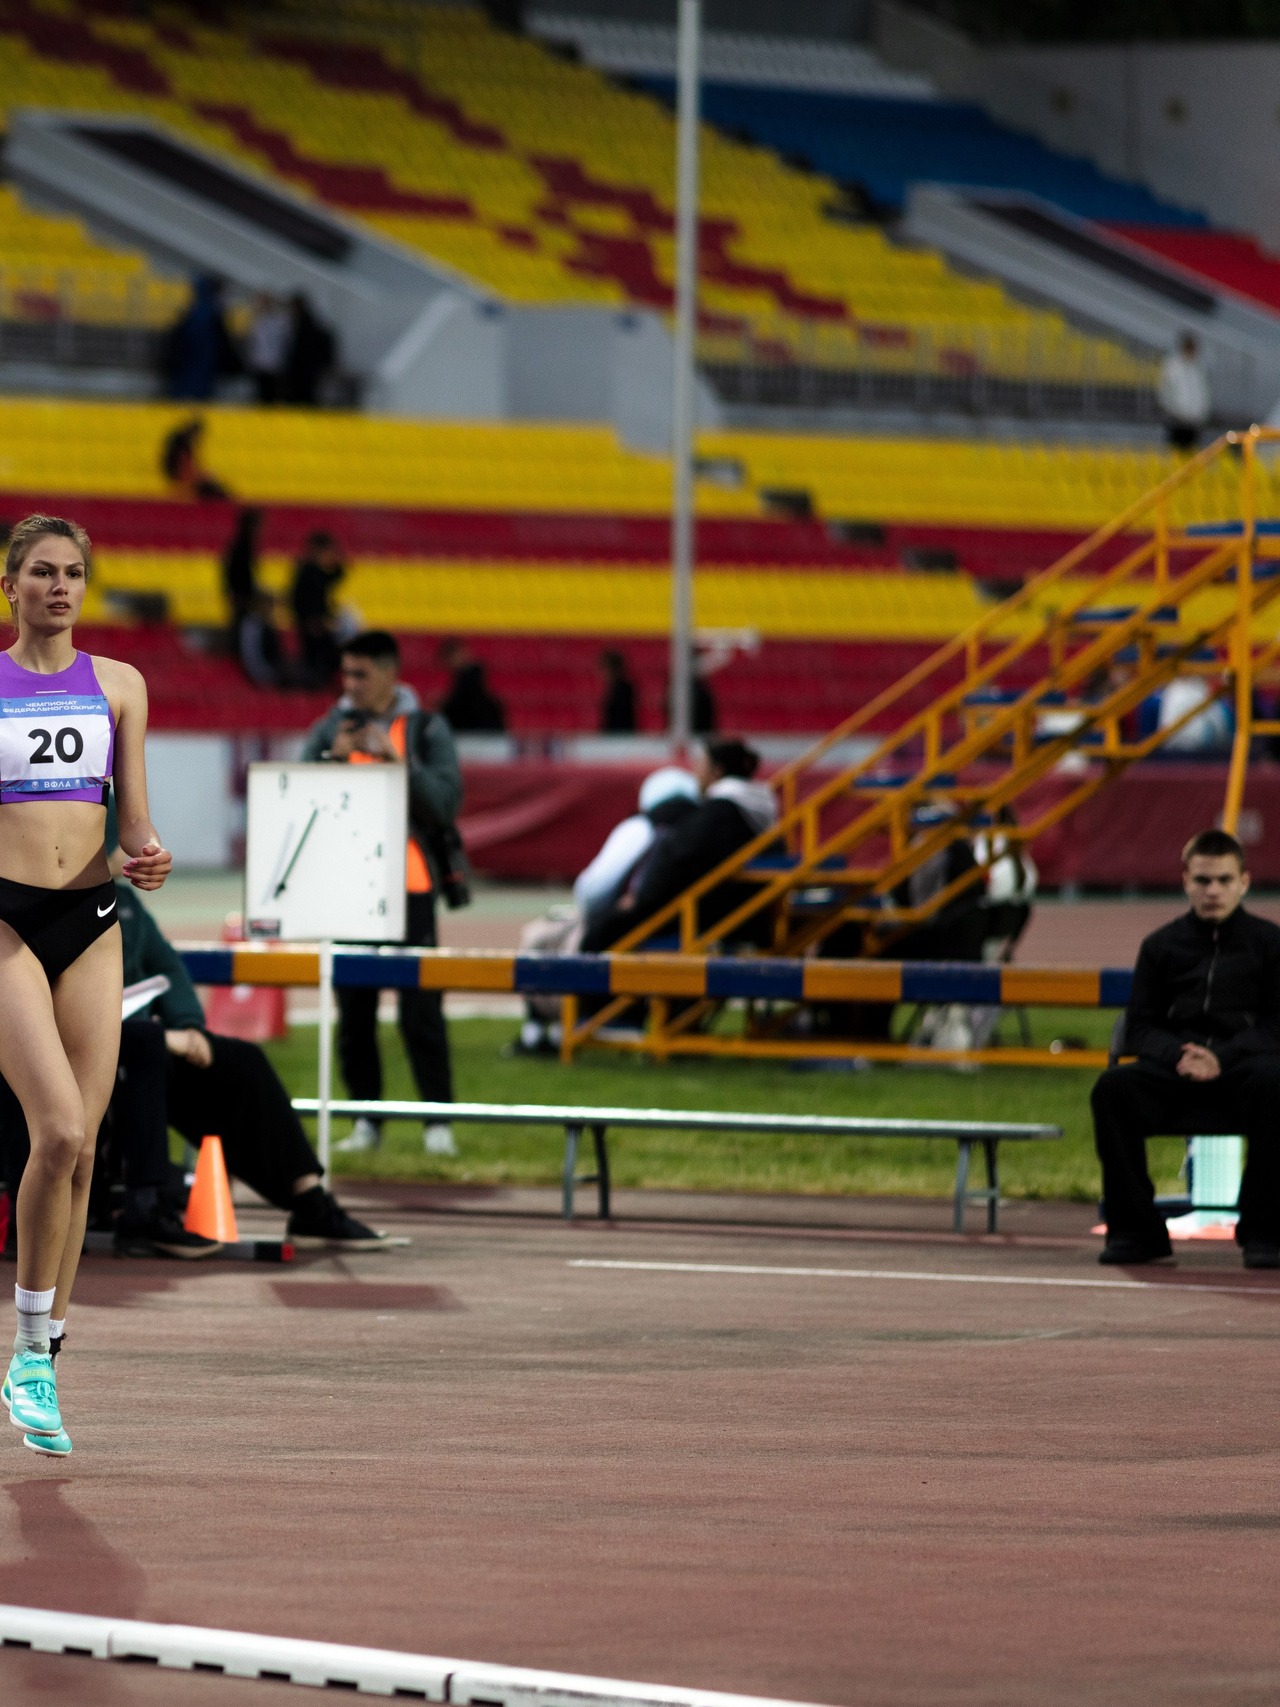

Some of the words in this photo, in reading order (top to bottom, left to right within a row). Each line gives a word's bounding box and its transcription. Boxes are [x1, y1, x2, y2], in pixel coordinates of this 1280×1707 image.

[25, 700, 78, 708] ЧЕМПИОНАТ
[2, 706, 70, 714] ФЕДЕРАЛЬНОГО
[27, 726, 84, 765] 20
[43, 781, 72, 789] ВФЛА
